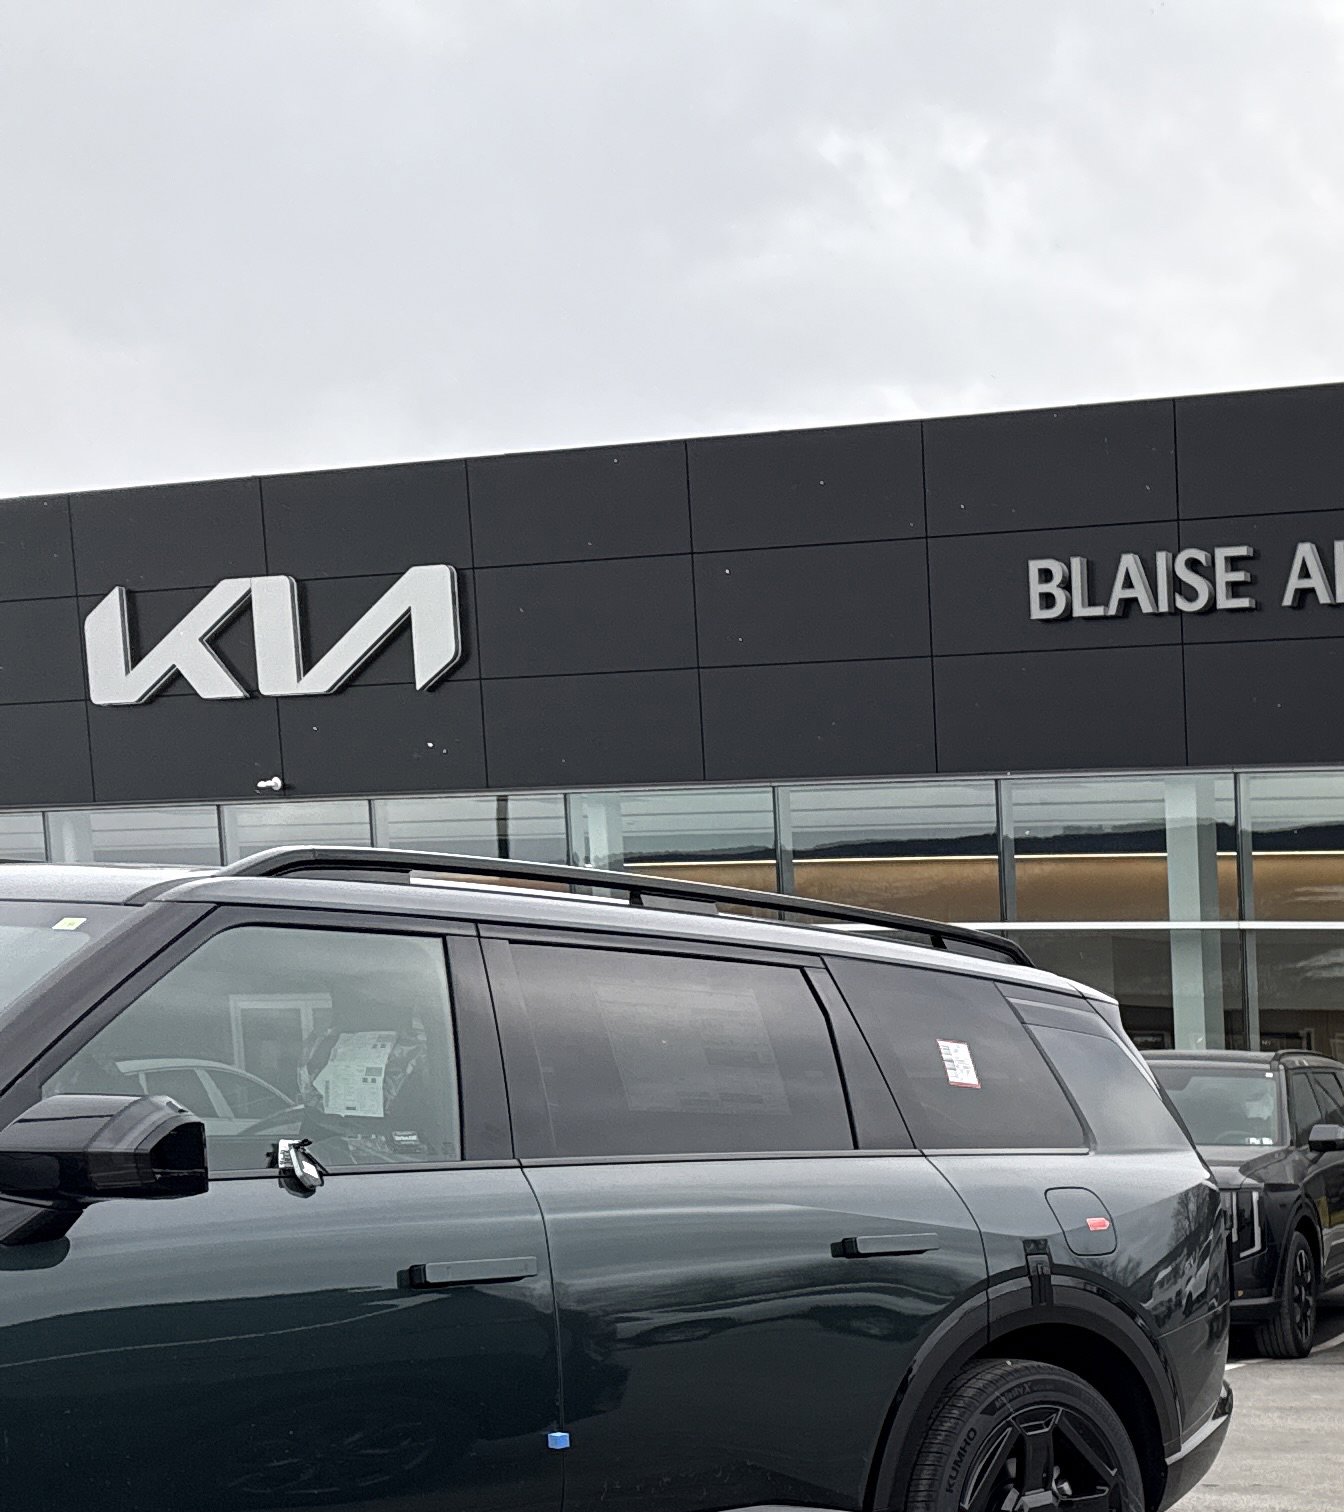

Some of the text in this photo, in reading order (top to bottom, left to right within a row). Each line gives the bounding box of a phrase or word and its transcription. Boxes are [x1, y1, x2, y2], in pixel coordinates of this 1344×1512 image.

[1028, 545, 1257, 621] BLAISE
[84, 564, 461, 706] KIA
[944, 1427, 978, 1494] KUMHO
